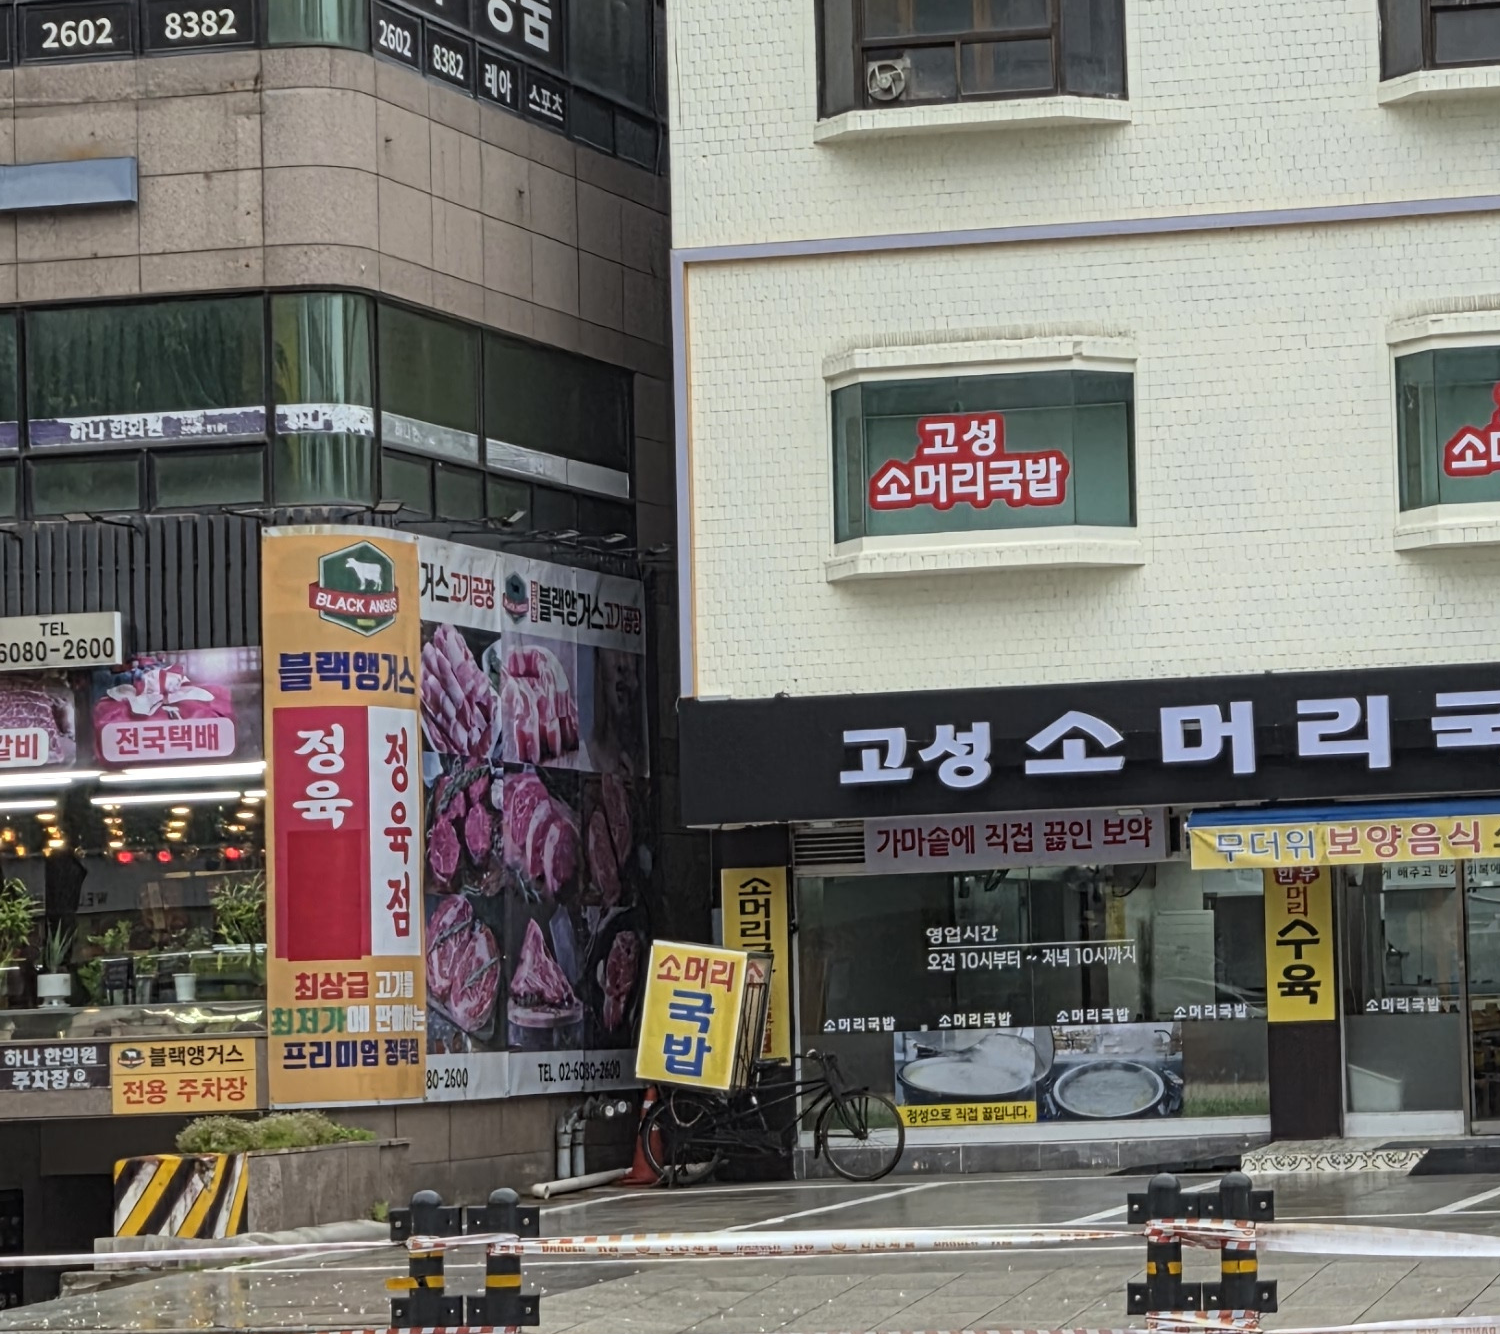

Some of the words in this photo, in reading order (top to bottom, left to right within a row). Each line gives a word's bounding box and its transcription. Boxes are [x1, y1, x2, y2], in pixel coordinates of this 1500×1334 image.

[41, 16, 113, 50] 2602
[163, 8, 237, 41] 8382
[379, 19, 412, 58] 2602
[432, 43, 464, 81] 8382
[484, 62, 512, 103] 레아
[922, 420, 998, 458] 고성
[875, 457, 1064, 506] 소머리국밥
[315, 592, 366, 613] BLACK
[368, 596, 398, 614] ANGUS
[39, 622, 70, 637] TEL
[115, 722, 220, 755] 전국택배
[839, 720, 993, 789] 고성
[292, 723, 354, 831] 정육
[383, 726, 413, 938] 정육점
[876, 824, 976, 859] 가마솥에
[984, 822, 1034, 855] 직접
[1042, 819, 1093, 852] 끓인
[1102, 817, 1154, 848] 보약
[1326, 817, 1484, 859] 보양음식
[656, 953, 736, 993] 소머리
[926, 952, 956, 972] 오전
[960, 950, 1021, 970] 10시부터
[1041, 948, 1070, 967] 저녁
[1075, 944, 1137, 965] 10시까지
[1275, 918, 1322, 1005] 수육
[294, 971, 370, 1001] 최상급
[938, 1010, 1012, 1029] 소머리국밥
[1056, 1006, 1130, 1024] 소머리국밥
[1173, 1001, 1248, 1021] 소머리국밥
[1366, 996, 1441, 1014] 소머리국밥
[662, 988, 716, 1078] 국밥
[822, 1014, 896, 1033] 소머리국밥
[4, 1048, 41, 1068] 하나
[44, 1046, 98, 1066] 한의원
[148, 1044, 245, 1068] 블랙앵거스
[283, 1038, 380, 1070] 프리미엄
[12, 1069, 69, 1091] 주차장
[122, 1079, 169, 1105] 전용
[177, 1076, 248, 1103] 주차장
[906, 1108, 952, 1124] 정성으로
[956, 1106, 978, 1122] 직접
